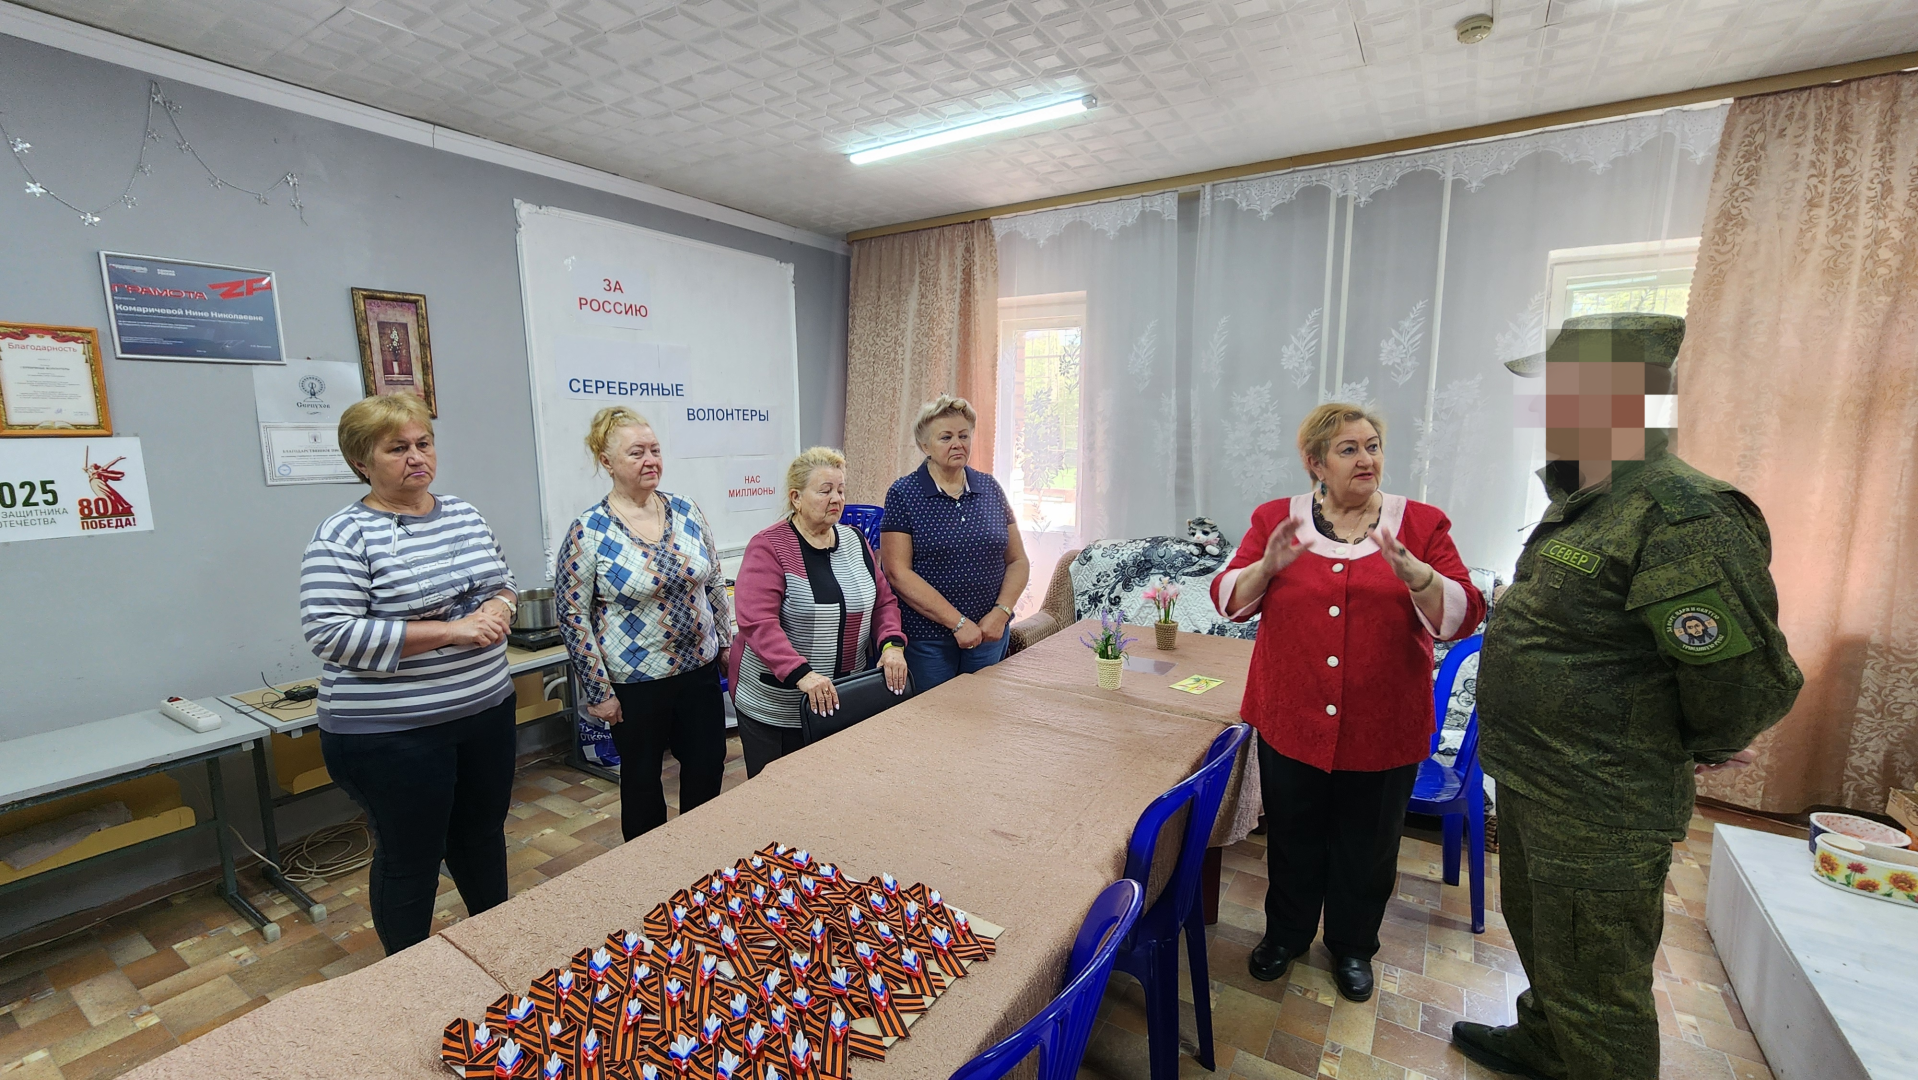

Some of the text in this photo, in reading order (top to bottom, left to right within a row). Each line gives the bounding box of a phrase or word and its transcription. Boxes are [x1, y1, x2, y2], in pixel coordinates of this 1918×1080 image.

[111, 283, 208, 300] ГРАМОТА
[603, 278, 624, 294] ЗА
[115, 303, 184, 316] Комаричевой
[185, 309, 209, 318] Нине
[211, 311, 264, 322] Николаевне
[578, 296, 648, 318] РОССИЮ
[7, 342, 78, 353] Благодарность
[568, 378, 685, 397] СЕРЕБРЯНЫЕ
[686, 408, 769, 422] ВОЛОНТЕРЫ
[744, 475, 761, 484] НАС
[728, 486, 776, 498] МИЛЛИОНЫ
[1, 508, 69, 519] ЗАЩИТНИКА
[78, 497, 109, 518] 80
[81, 517, 137, 530] ПОБЕДА!
[1550, 545, 1589, 566] СЕВЕР
